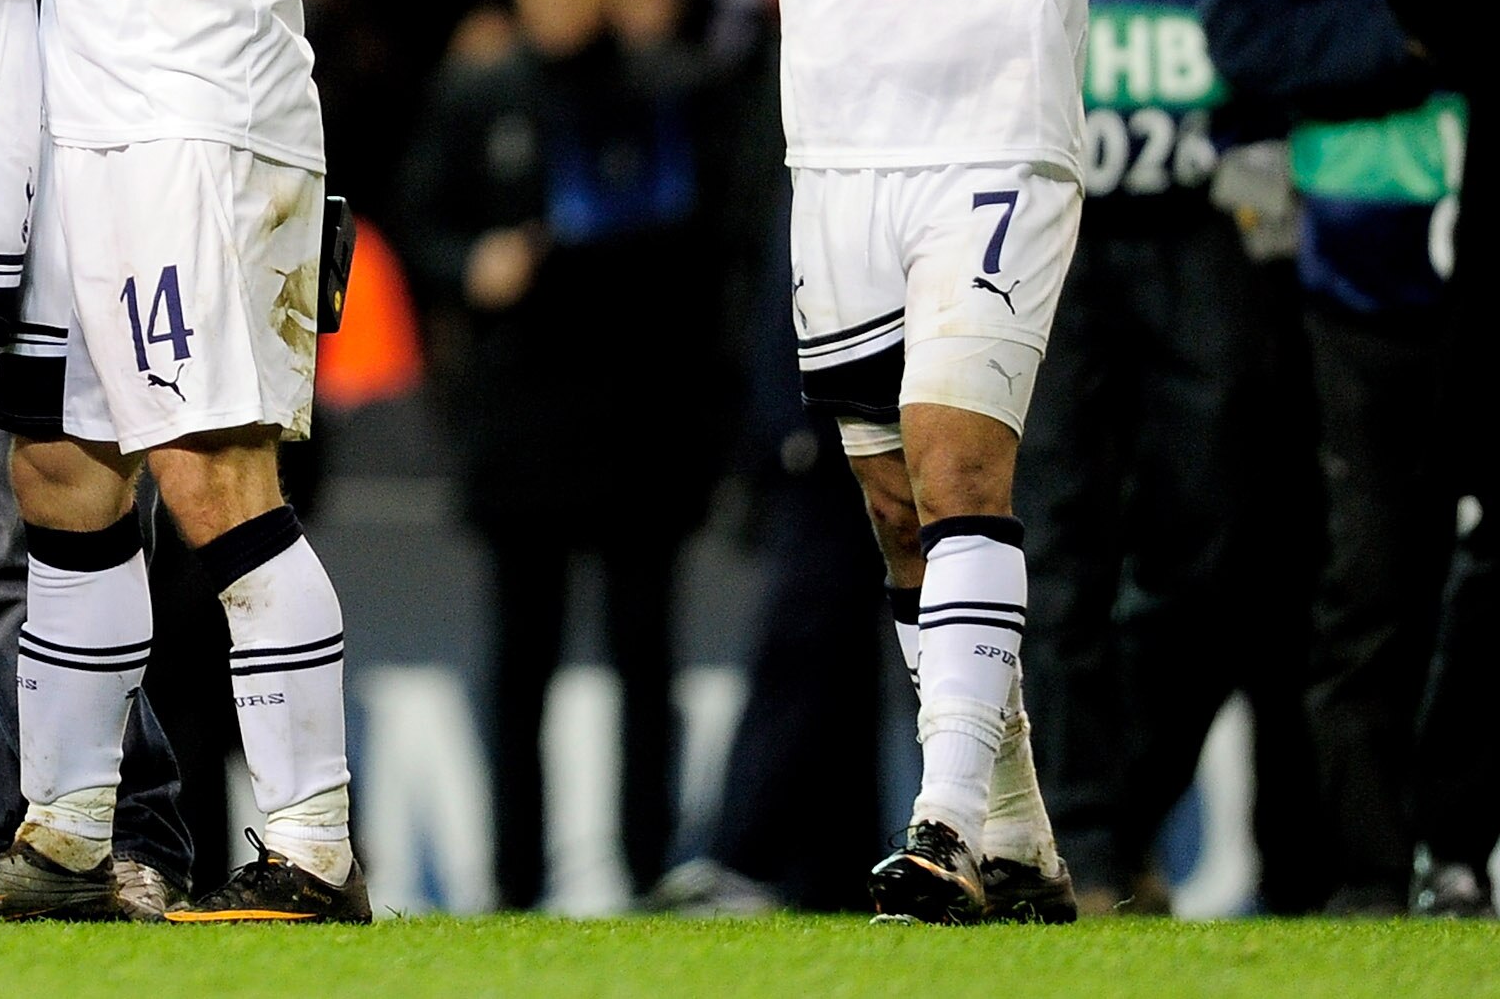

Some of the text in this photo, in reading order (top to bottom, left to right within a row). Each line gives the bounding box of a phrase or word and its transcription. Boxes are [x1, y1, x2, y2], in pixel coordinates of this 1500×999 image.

[1092, 14, 1215, 103] HB
[972, 190, 1019, 274] 7
[120, 265, 194, 372] 14
[973, 644, 1017, 668] SPU
[235, 692, 285, 707] URS
